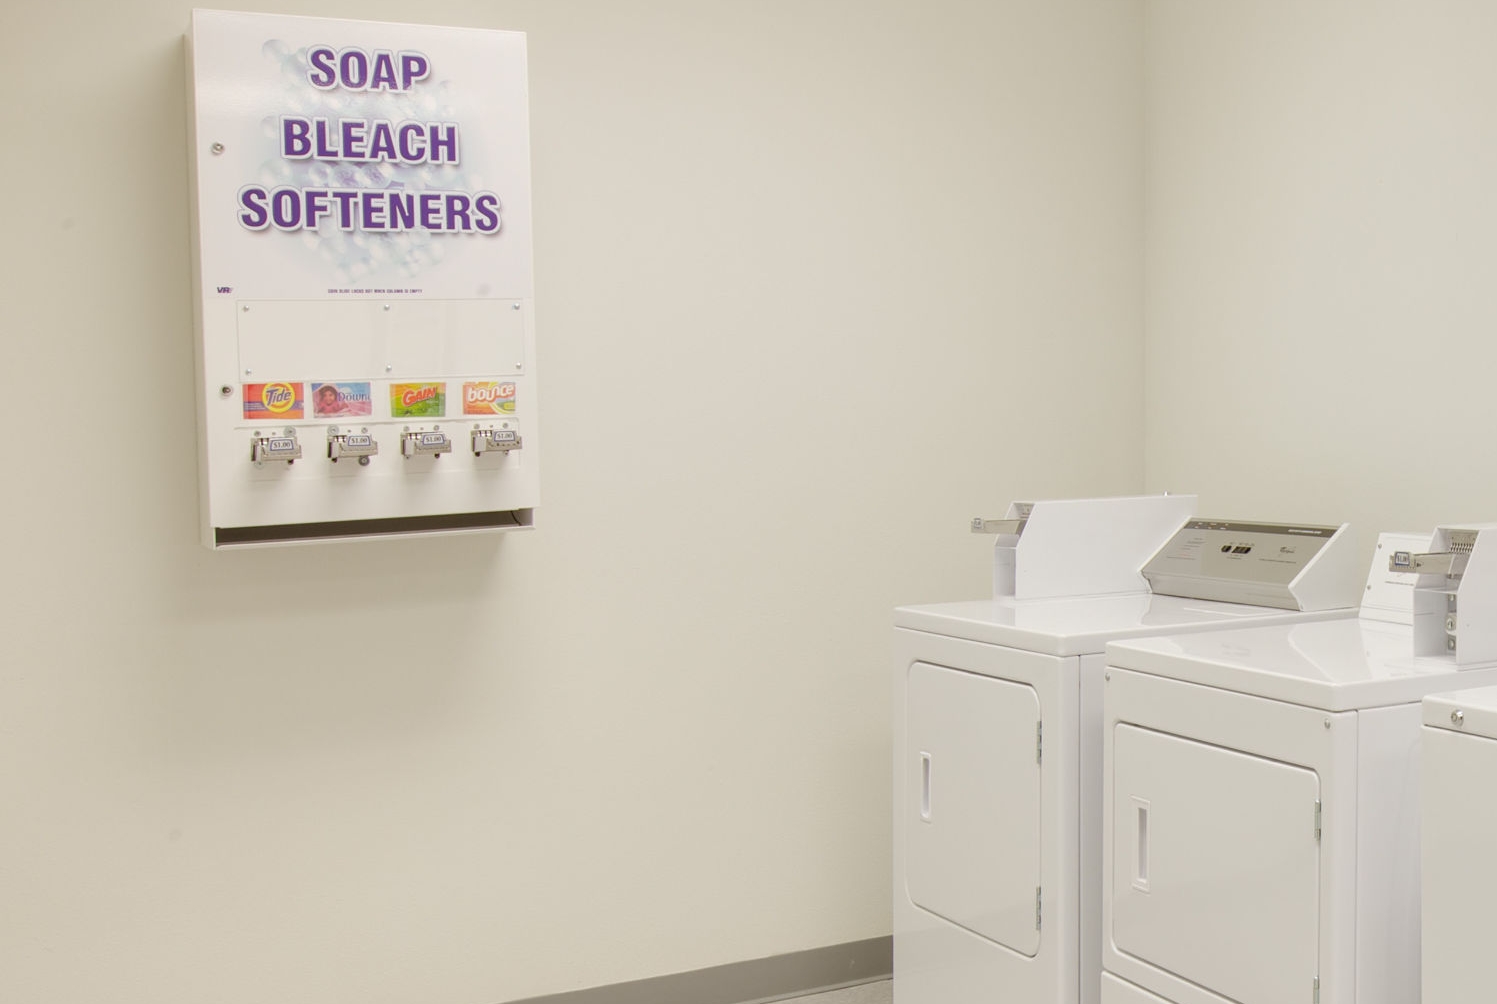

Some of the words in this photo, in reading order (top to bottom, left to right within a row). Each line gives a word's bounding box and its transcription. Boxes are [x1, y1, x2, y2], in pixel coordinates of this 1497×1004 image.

[309, 48, 428, 91] SOAP
[282, 118, 458, 163] BLEACH
[240, 188, 499, 232] SOFTENERS
[265, 387, 292, 407] Tide
[467, 383, 515, 403] bounce
[273, 441, 291, 449] $1.00
[351, 436, 368, 444] $1.00
[425, 436, 441, 444] $1.00
